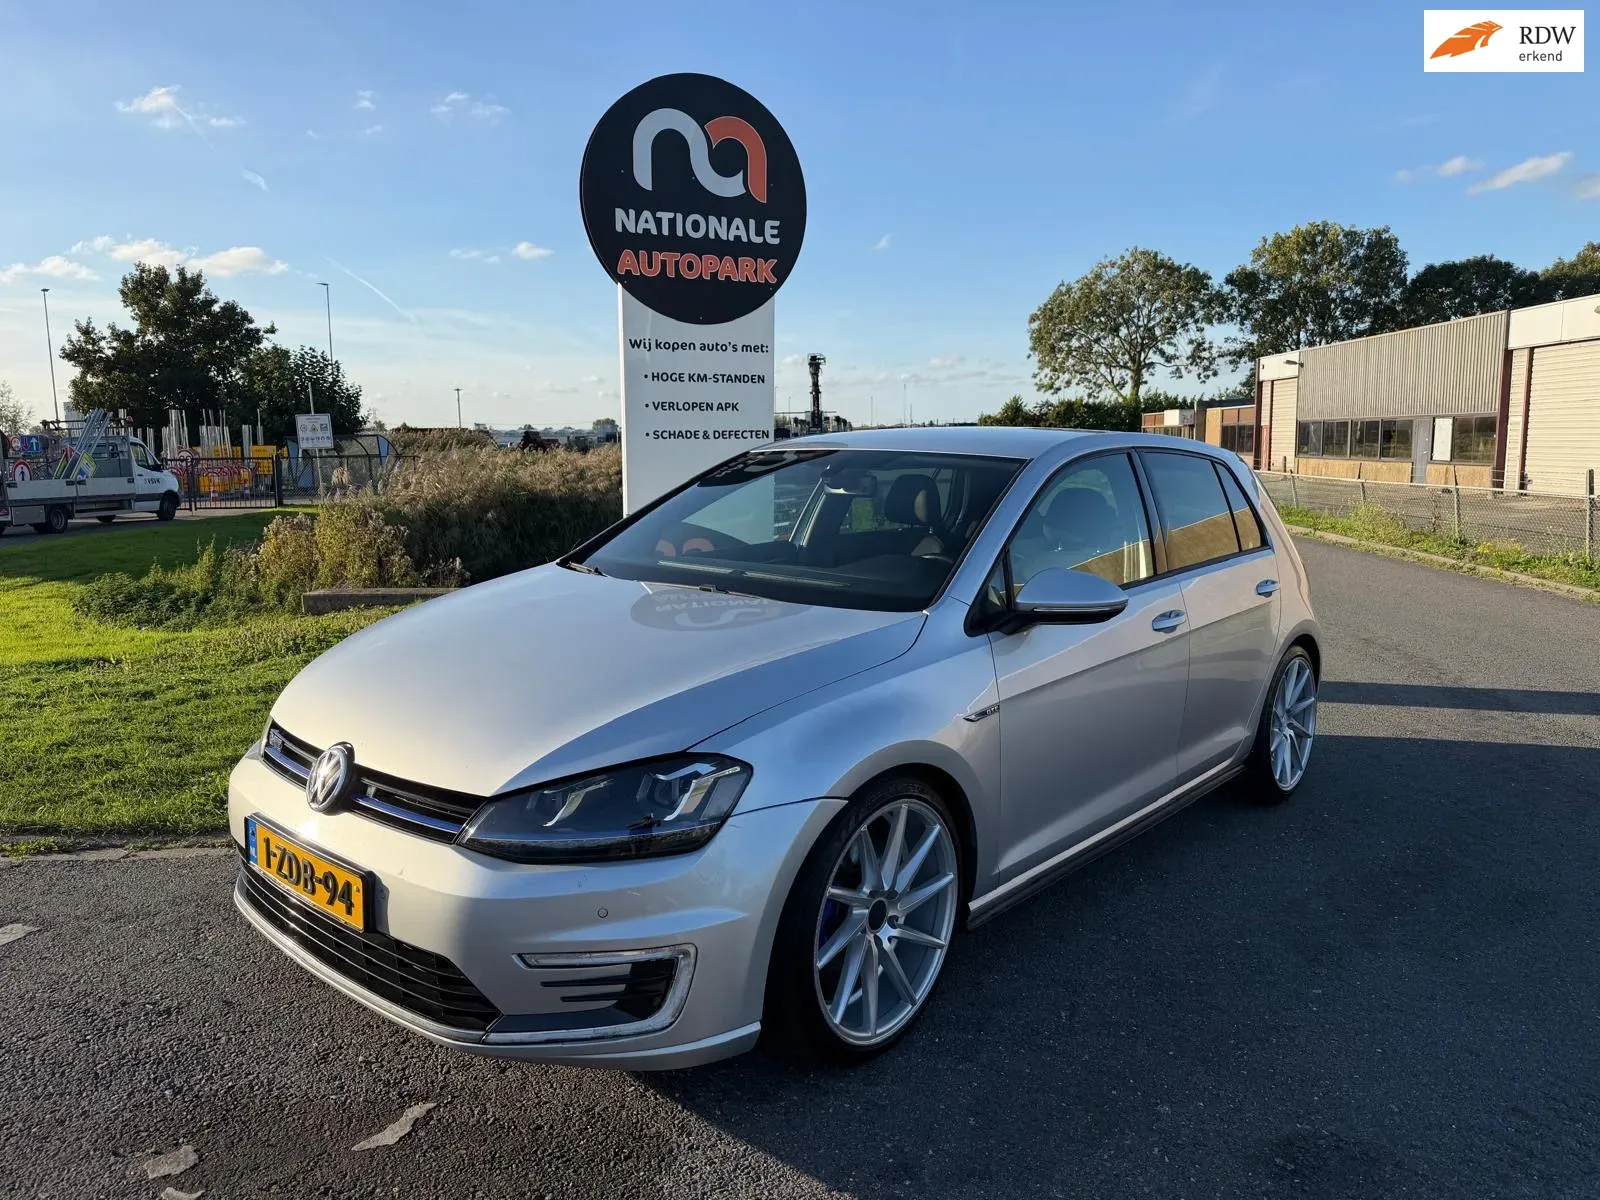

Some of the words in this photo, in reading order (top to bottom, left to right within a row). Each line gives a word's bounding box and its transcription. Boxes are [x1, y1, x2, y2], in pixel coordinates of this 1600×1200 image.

[614, 207, 780, 245] NATIONALE
[617, 249, 777, 283] AUTOPARK
[629, 338, 651, 351] Wij
[655, 339, 696, 352] kopen
[699, 341, 738, 353] auto's
[741, 343, 769, 353] met:
[651, 372, 685, 382] HOGE
[688, 373, 765, 384] KM-STANDEN
[652, 401, 714, 411] VERLOPEN
[716, 402, 739, 411] APK
[652, 430, 700, 440] SCHADE
[702, 430, 711, 440] &
[713, 430, 769, 439] DEFECTEN
[263, 837, 355, 916] 1-ZDB-94
